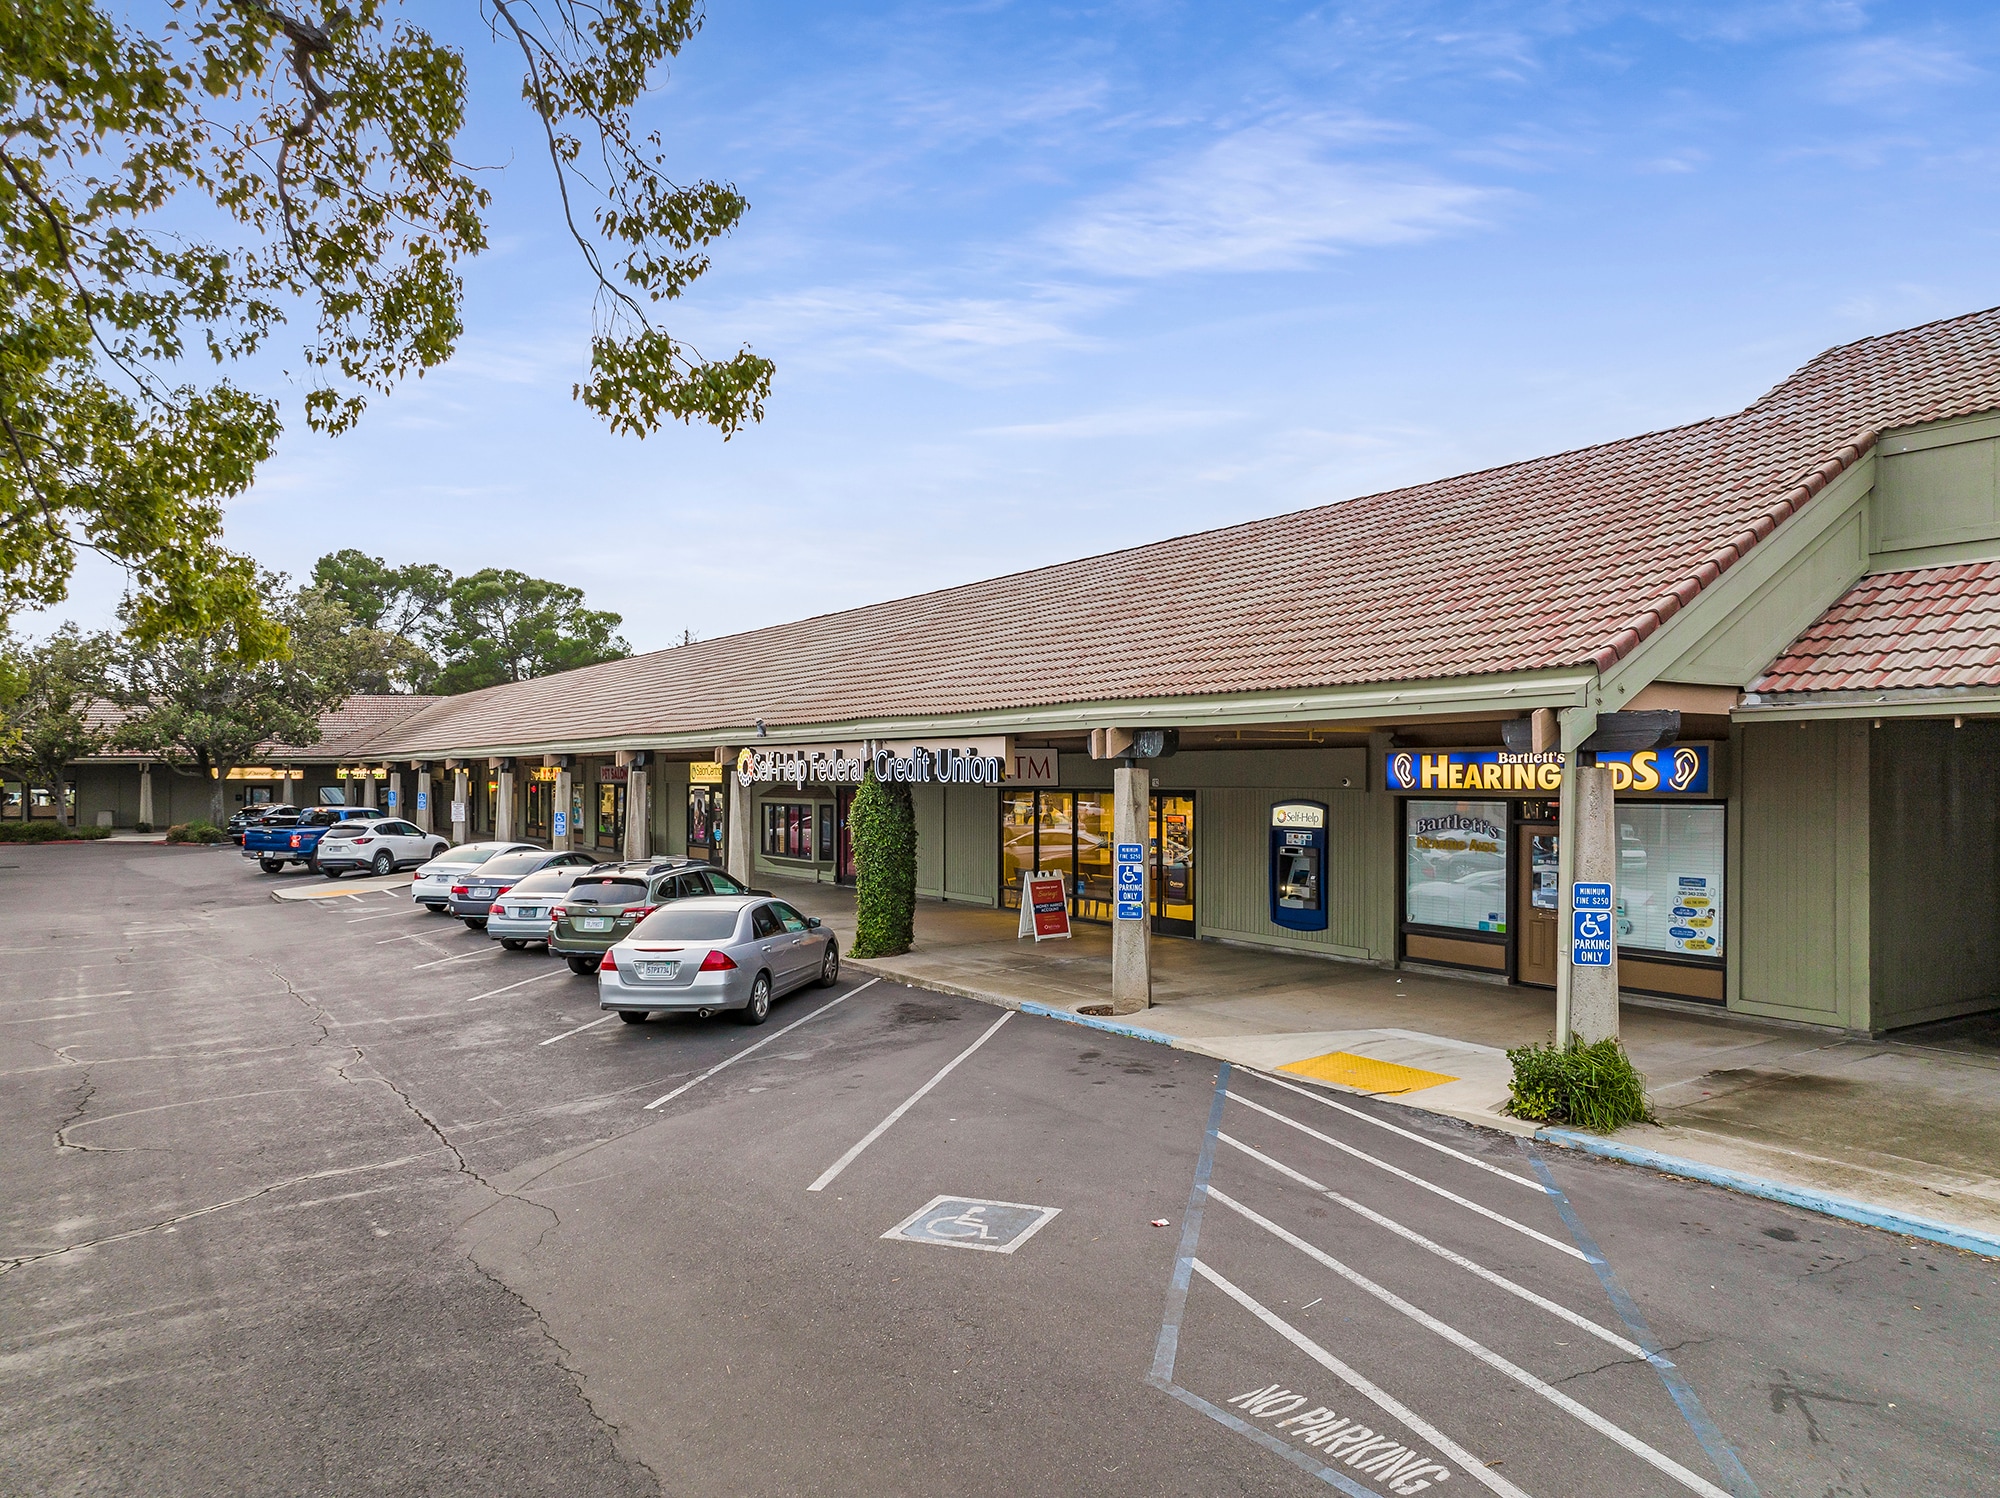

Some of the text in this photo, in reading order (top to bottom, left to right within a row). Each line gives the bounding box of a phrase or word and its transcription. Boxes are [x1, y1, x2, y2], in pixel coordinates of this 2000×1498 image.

[1498, 752, 1566, 764] Bartlett's
[752, 747, 999, 791] Self-Help Federal Credit Union
[1005, 756, 1051, 780] TM
[1421, 754, 1563, 790] HEARING
[1286, 811, 1319, 826] Self-Help
[1416, 814, 1498, 839] Bartlett's
[1416, 836, 1498, 852] HEARING AIDS
[1119, 884, 1143, 892] PARKING
[1579, 887, 1606, 896] MINIMUM
[1576, 896, 1609, 905] FINE $250
[1574, 939, 1610, 951] PARKING
[1581, 951, 1604, 962] ONLY
[1226, 1383, 1451, 1495] NO PARKING
